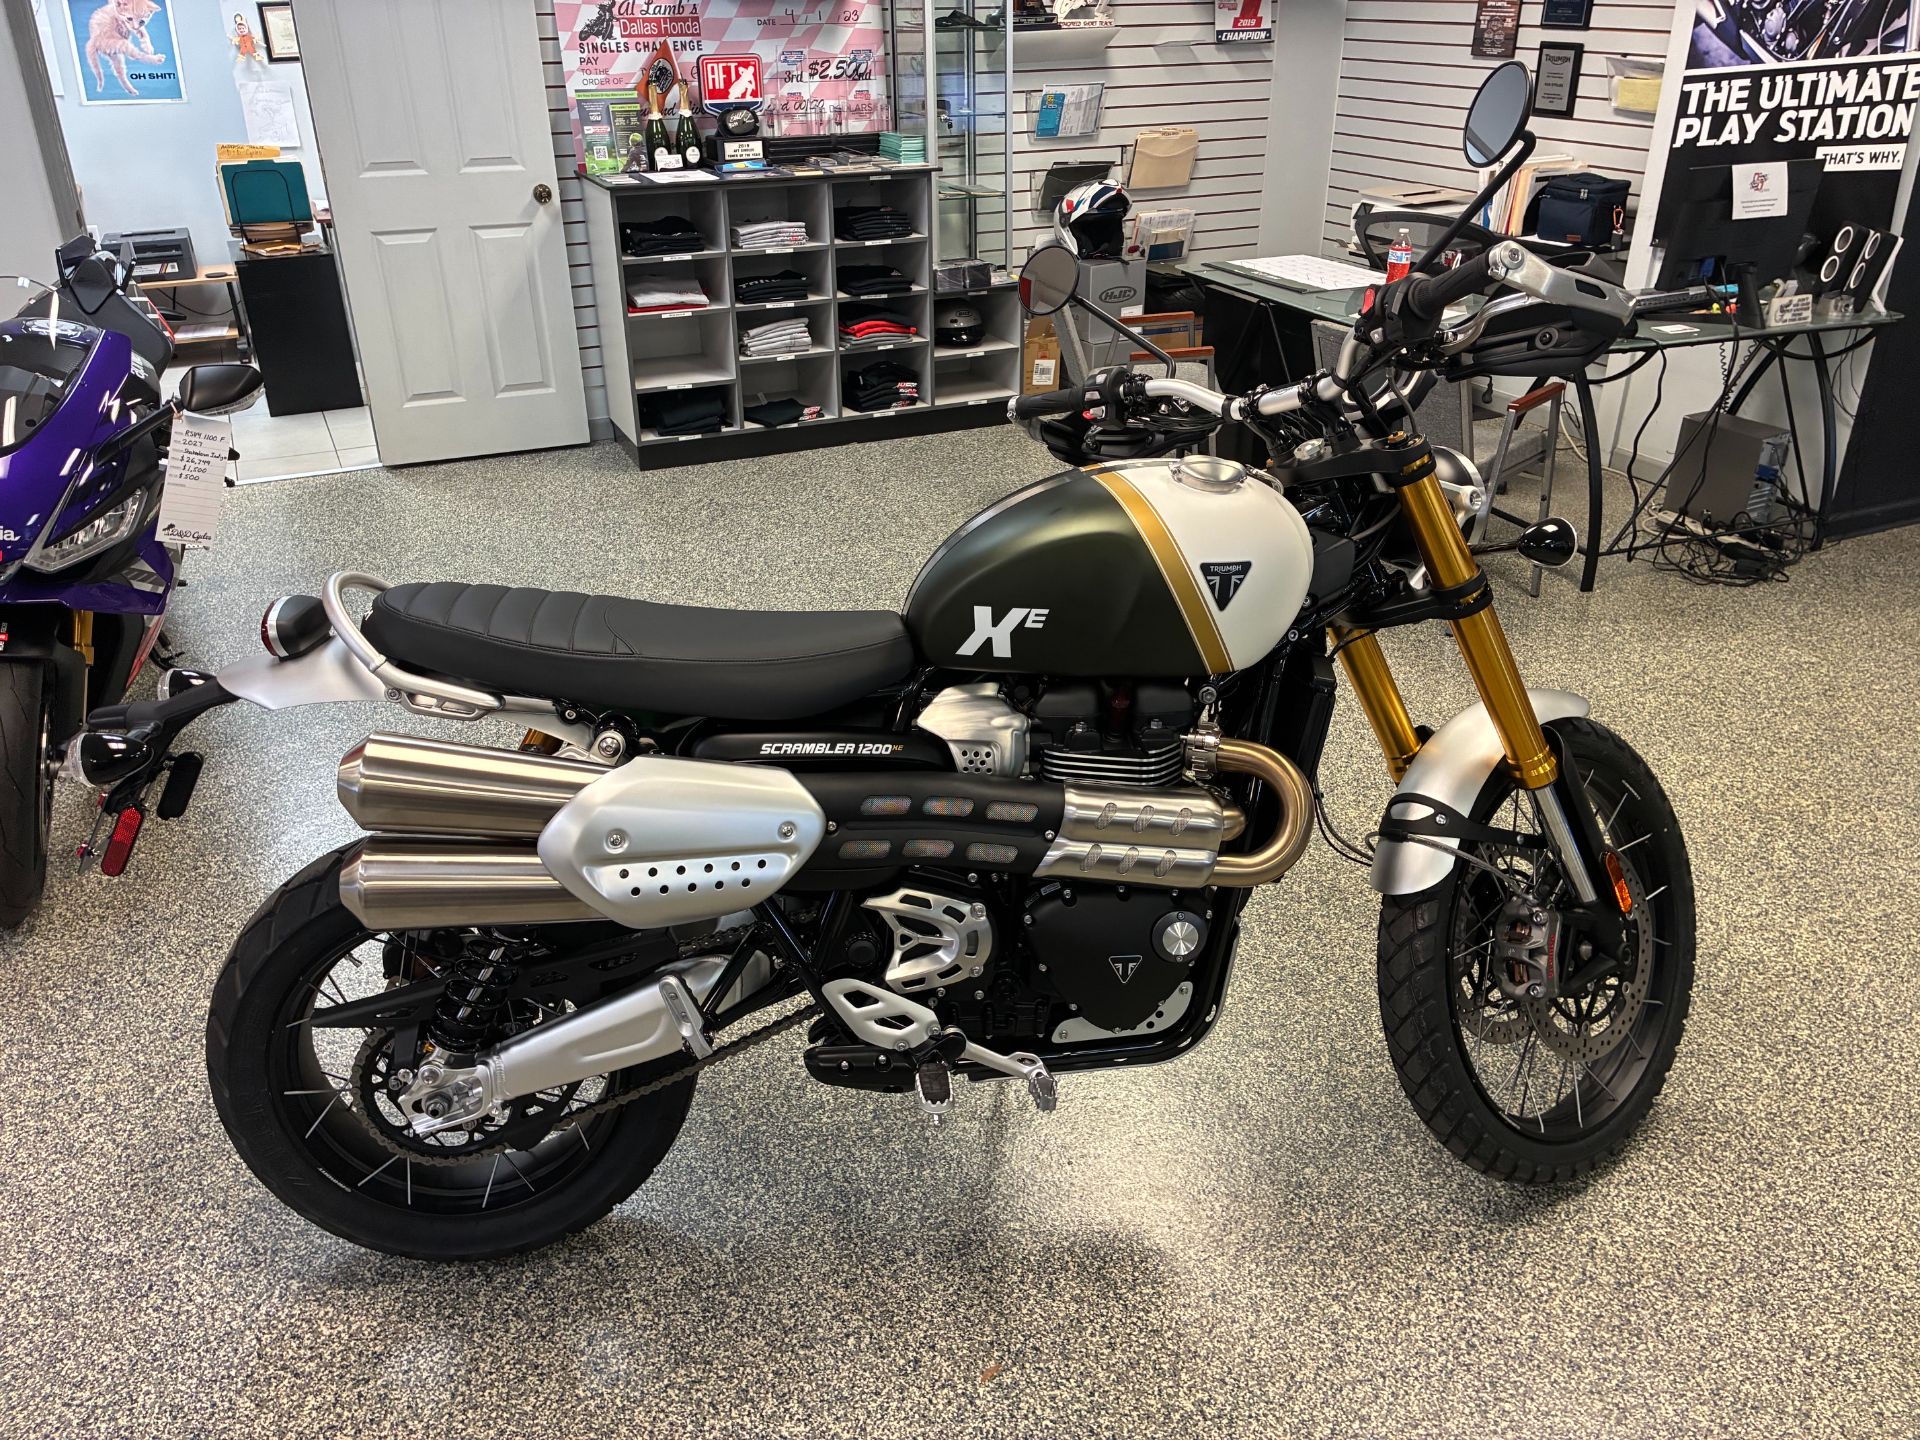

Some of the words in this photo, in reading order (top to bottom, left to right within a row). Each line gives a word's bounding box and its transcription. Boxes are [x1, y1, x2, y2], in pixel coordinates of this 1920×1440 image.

[617, 0, 635, 16] Al
[640, 0, 699, 16] Lamb's
[785, 8, 795, 23] 4
[843, 10, 859, 21] 23
[621, 18, 658, 35] Dallas
[661, 17, 699, 35] Honda
[1237, 18, 1256, 27] 2019
[1221, 31, 1266, 41] CHAMPION
[579, 41, 630, 54] SINGLES
[635, 40, 703, 52] CHAENGE
[580, 57, 599, 66] PAY
[148, 72, 176, 80] SHIT!
[581, 68, 592, 76] TO
[594, 67, 609, 76] THE
[707, 63, 738, 90] AFT
[784, 71, 803, 83] 3rd
[582, 78, 610, 86] ORDER
[612, 77, 624, 85] OF
[1682, 78, 1751, 115] THE
[1758, 63, 1920, 111] ULTIMATE
[1672, 111, 1770, 149] PLAY
[1773, 102, 1917, 143] STATION
[1822, 151, 1864, 166] THAT'S
[1869, 150, 1901, 164] WHY.
[1103, 289, 1132, 301] HJC
[203, 434, 218, 442] 1100
[178, 473, 200, 481] $500
[1210, 564, 1242, 573] TRIUMPH
[760, 743, 855, 755] SCRAMBLER
